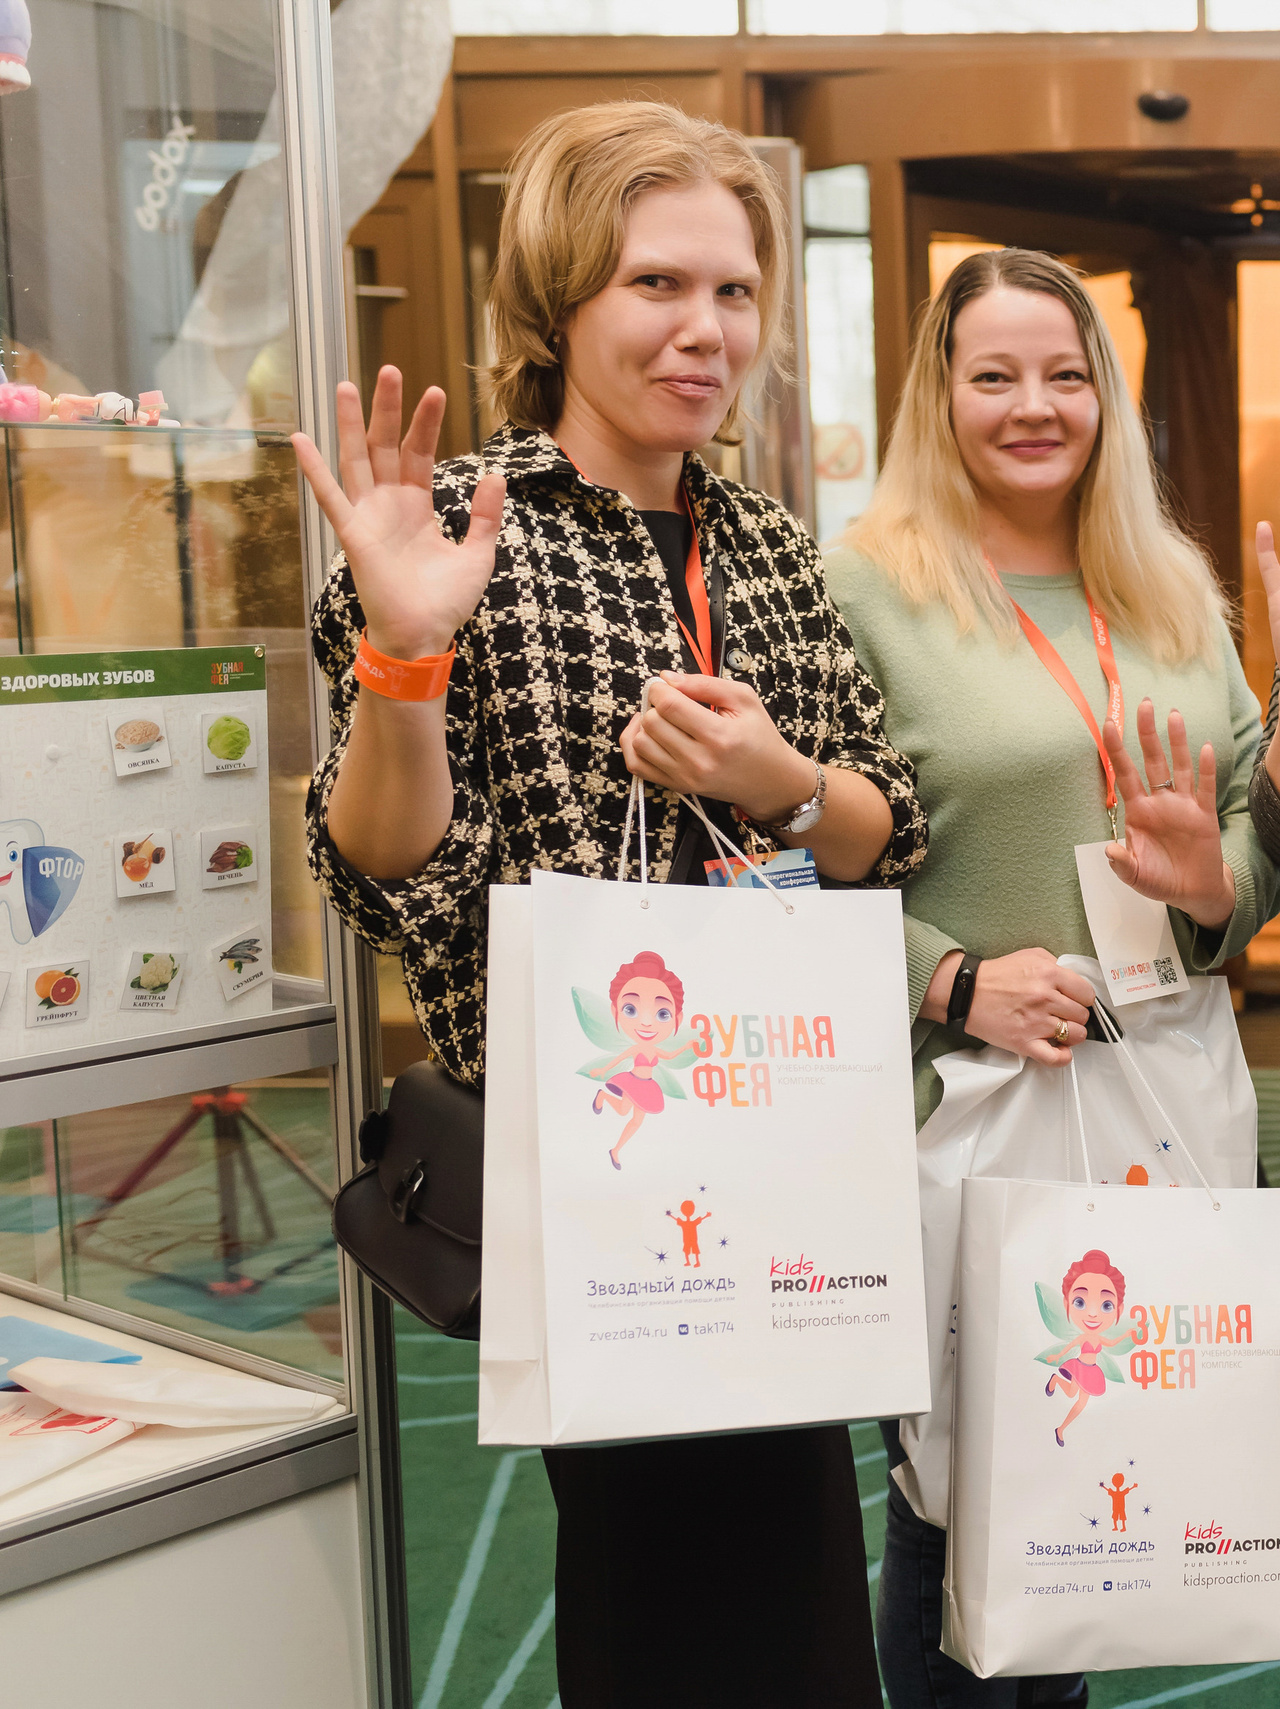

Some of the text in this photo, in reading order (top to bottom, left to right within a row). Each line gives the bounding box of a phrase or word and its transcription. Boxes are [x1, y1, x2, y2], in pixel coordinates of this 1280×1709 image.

[211, 661, 244, 674] ЗУБНАЯ
[1, 669, 155, 692] ЗДОРОВЫХ ЗУБОВ
[211, 674, 229, 685] ФЕЯ
[127, 758, 160, 769] ОВСЯНКА
[216, 762, 246, 771] КАПУСТА
[39, 856, 84, 880] ФТОР
[217, 872, 243, 881] ПЕЧЕНЬ
[1111, 965, 1137, 980] ЗУБНАЯ
[1137, 962, 1151, 974] ФЕЯ
[232, 970, 264, 991] СКУМБРИЯ
[36, 1010, 78, 1022] ГРЕЙПФРУТ
[691, 1014, 836, 1059] ЗУБНАЯ
[776, 1062, 883, 1074] УЧЕБНО-РАЗВИВАЮЩИЙ
[692, 1063, 773, 1107] ФЕЯ
[778, 1076, 826, 1086] КОМПЛЕКС
[770, 1253, 814, 1277] kids
[586, 1276, 736, 1297] Звездный дождь
[772, 1299, 845, 1308] PUBLISHING
[694, 1321, 735, 1335] tak174
[772, 1312, 890, 1332] kidsproaction.com
[1129, 1304, 1252, 1345] ЗУБНАЯ
[589, 1326, 668, 1342] zvezda74.ru
[1129, 1349, 1196, 1390] ФЕЯ
[1201, 1360, 1243, 1369] КОМПЛЕКС
[1184, 1519, 1223, 1541] kids
[1025, 1539, 1155, 1556] Звездный дождь
[1184, 1560, 1248, 1568] PUBLISHING
[1024, 1583, 1094, 1595] zvezda74.ru
[1116, 1579, 1151, 1591] tak174
